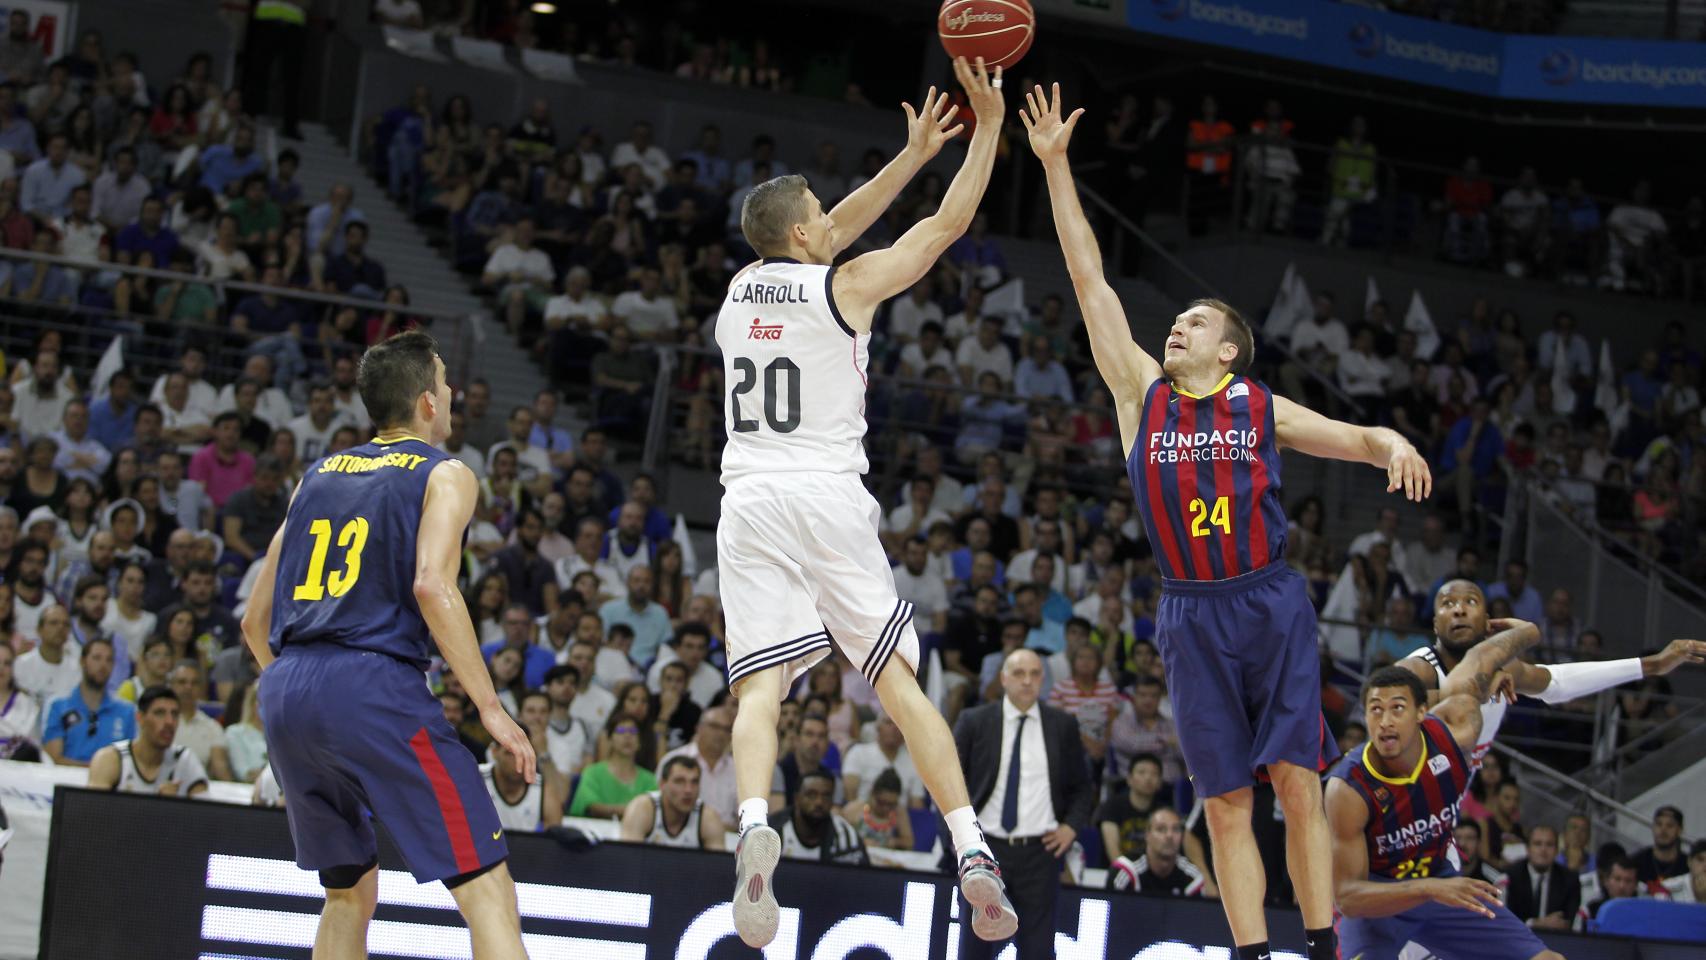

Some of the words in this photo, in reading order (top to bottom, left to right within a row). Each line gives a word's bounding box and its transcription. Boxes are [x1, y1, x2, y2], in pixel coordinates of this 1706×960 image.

[1385, 33, 1498, 76] barclaycard
[732, 283, 808, 304] CARROLL
[731, 357, 801, 434] 20
[1150, 427, 1257, 449] FUNDACIÓ
[1189, 496, 1231, 538] 24
[293, 517, 369, 601] 13
[1395, 856, 1433, 879] 25
